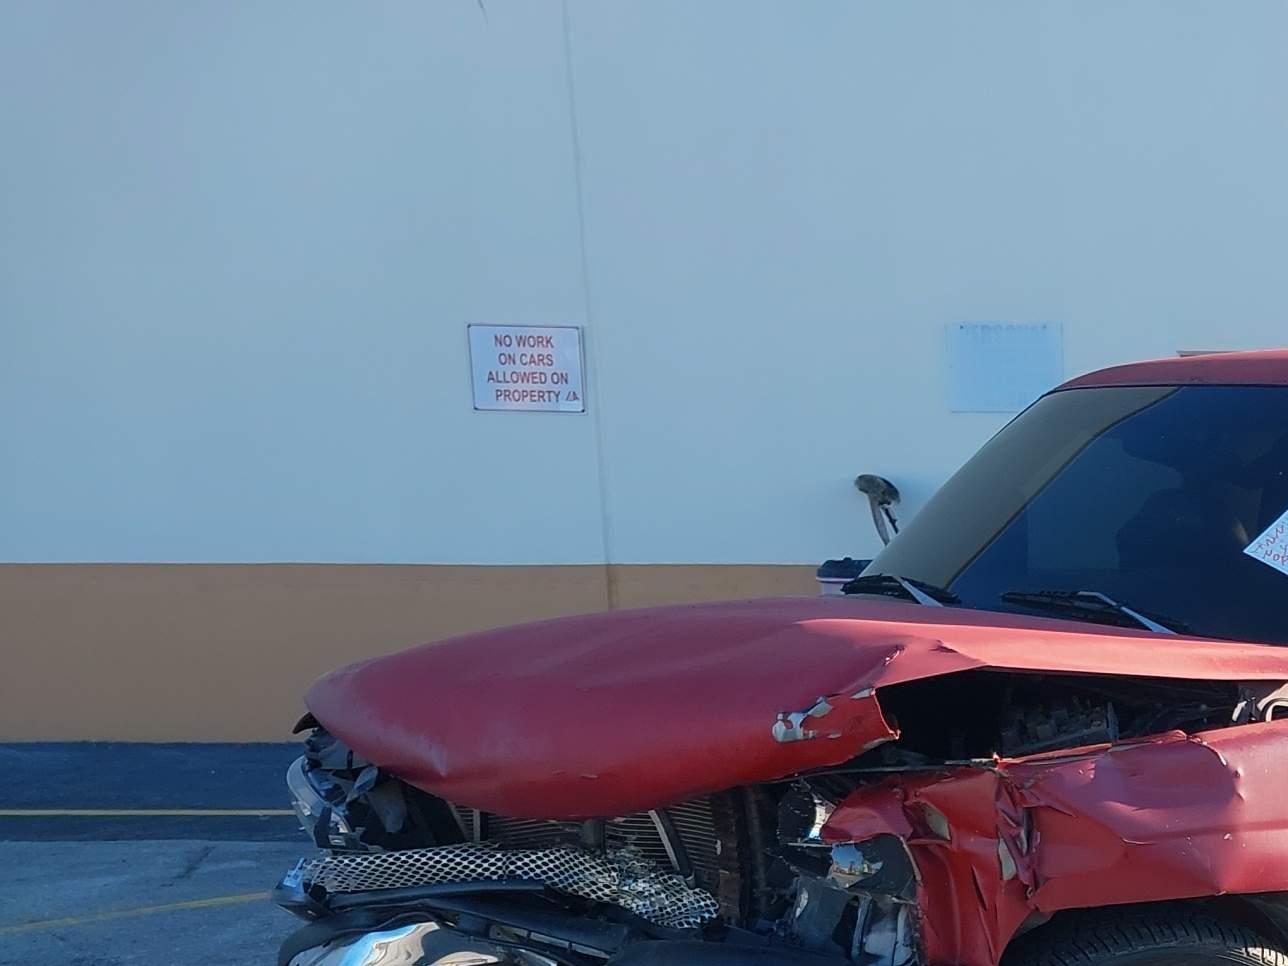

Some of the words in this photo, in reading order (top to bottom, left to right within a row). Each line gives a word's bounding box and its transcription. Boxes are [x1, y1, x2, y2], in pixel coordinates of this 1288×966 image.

[494, 334, 512, 348] NO
[515, 335, 555, 348] WORK
[498, 352, 516, 365] ON
[519, 353, 554, 366] CARS
[487, 371, 547, 384] ALLOWED
[551, 371, 569, 385] ON
[495, 389, 561, 403] PROPERTY
